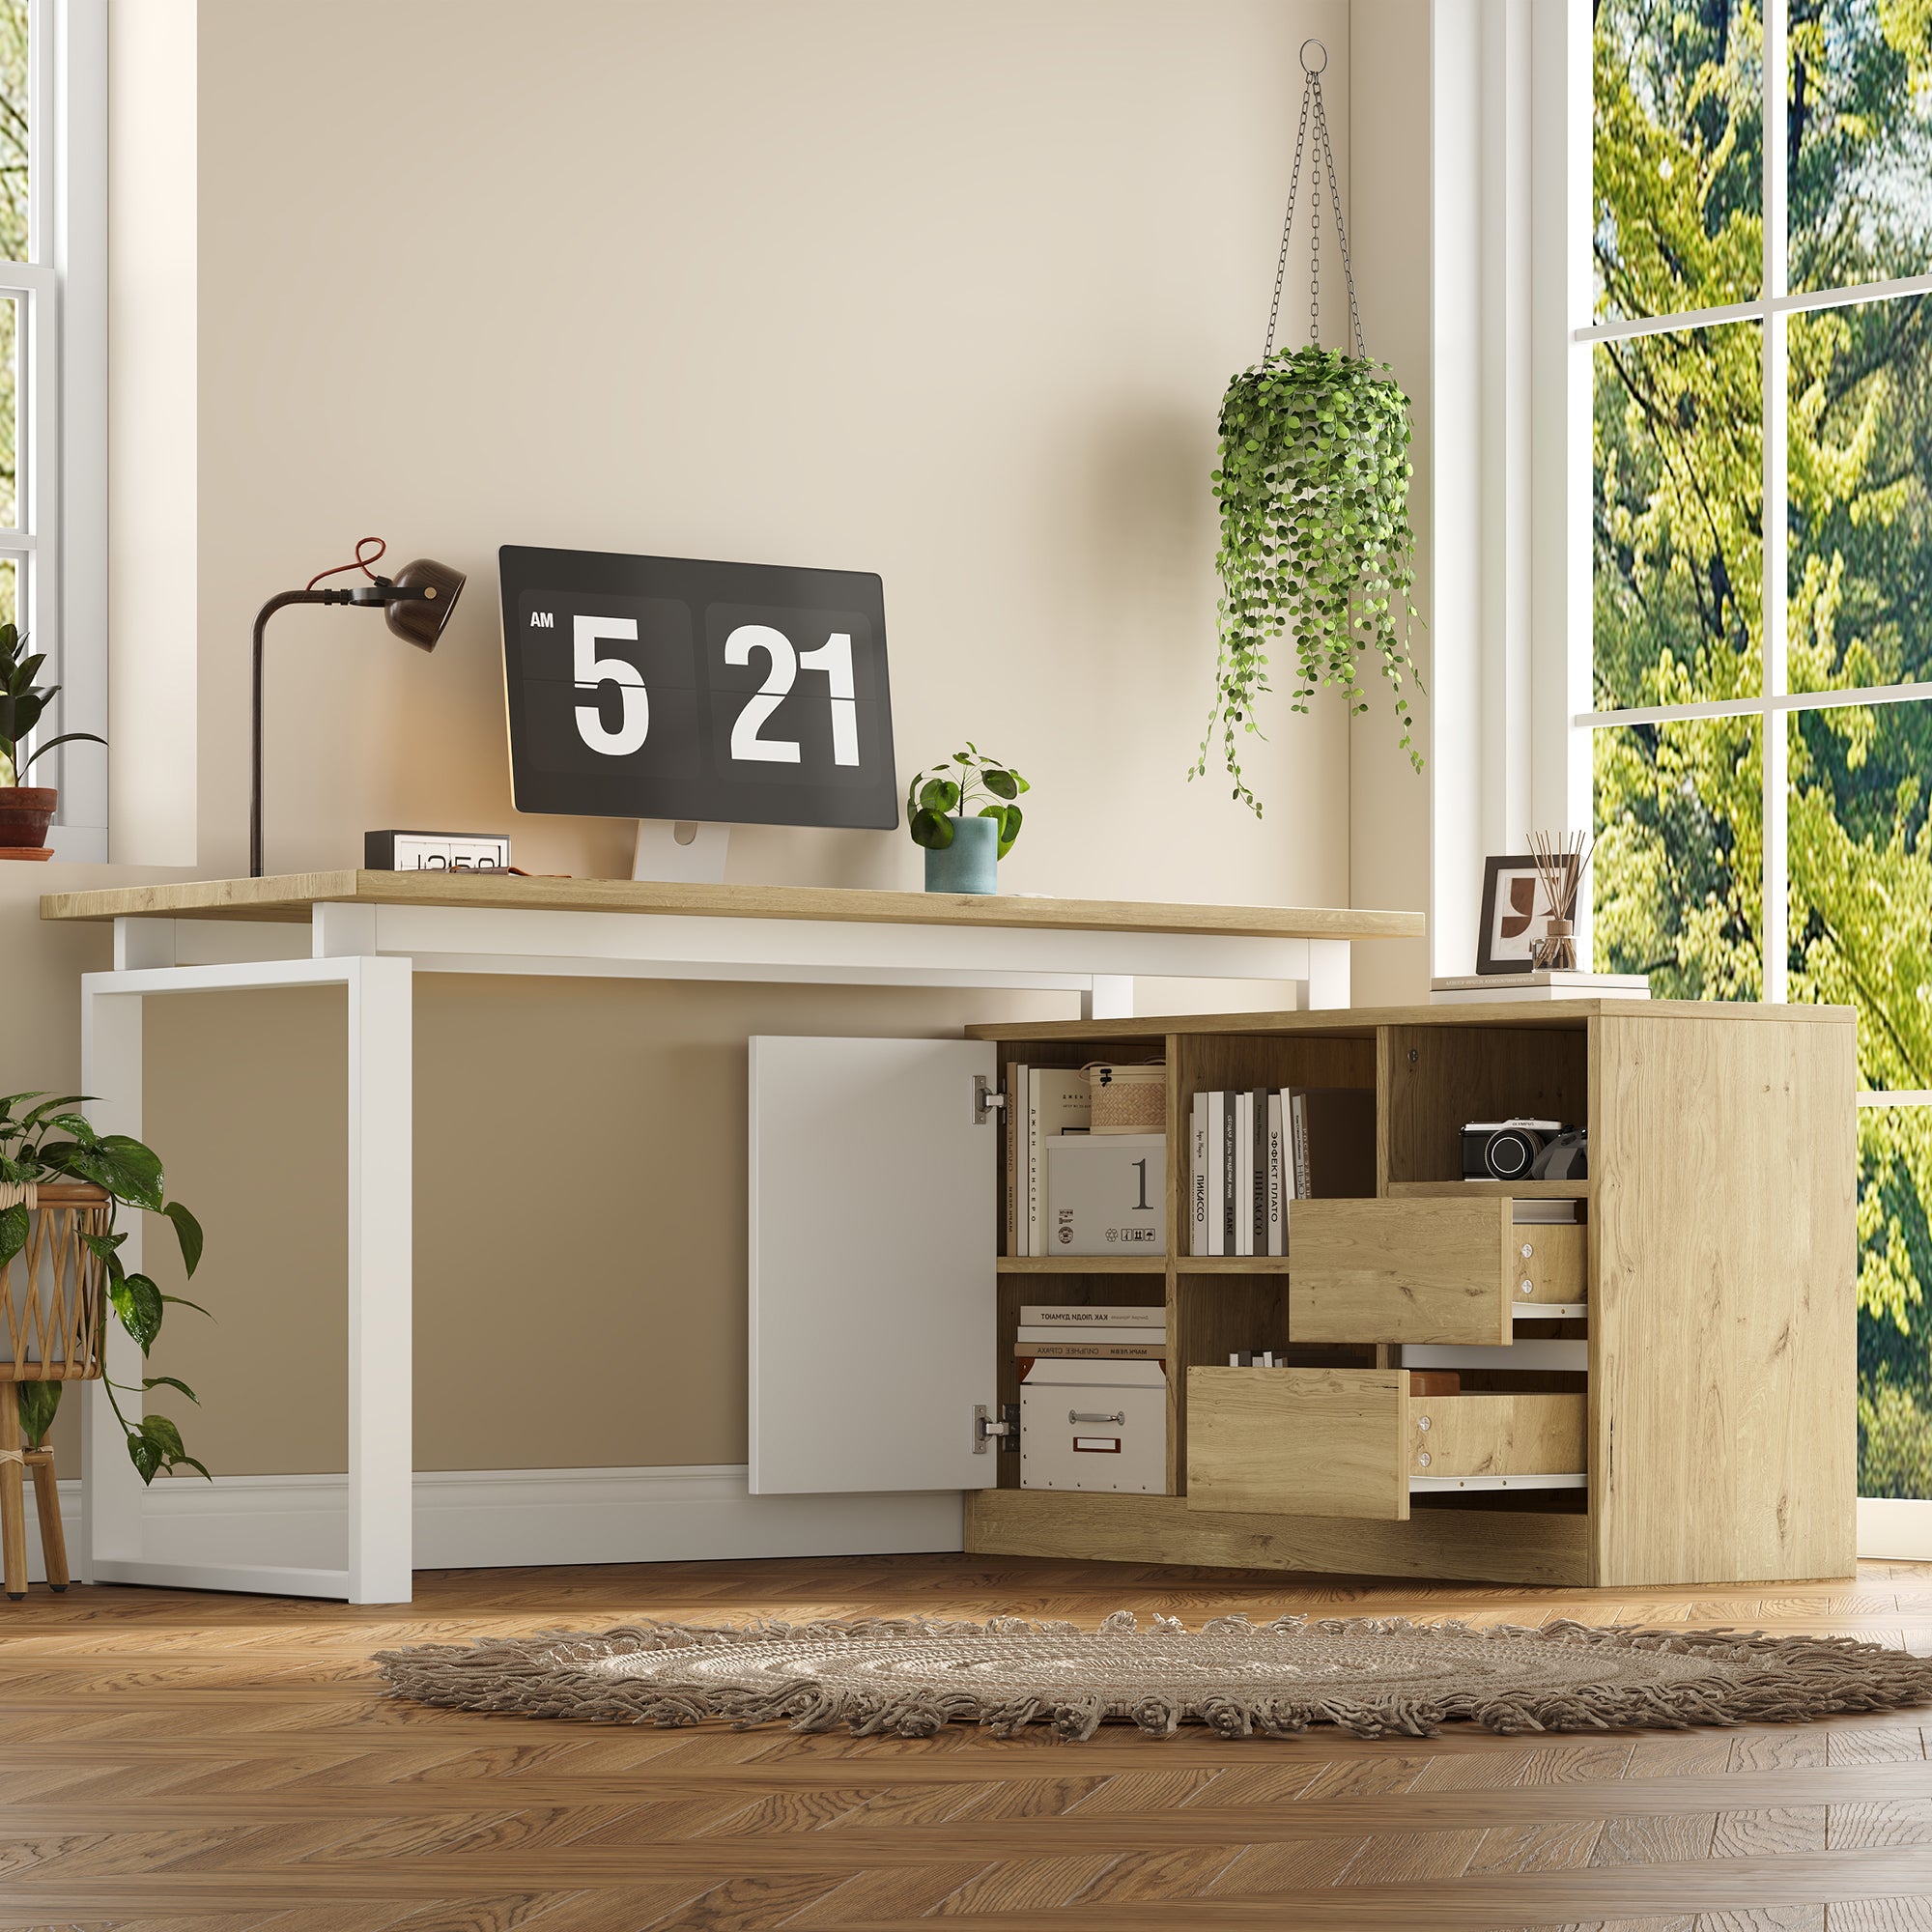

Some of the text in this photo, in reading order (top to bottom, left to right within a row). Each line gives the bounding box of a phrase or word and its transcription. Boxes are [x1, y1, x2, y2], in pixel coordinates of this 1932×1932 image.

[530, 611, 554, 629] AM
[573, 614, 860, 767] 5 21
[1132, 1158, 1153, 1209] 1
[1196, 1175, 1205, 1222] ПИКАССО
[1254, 1170, 1264, 1236] ПИКАССО
